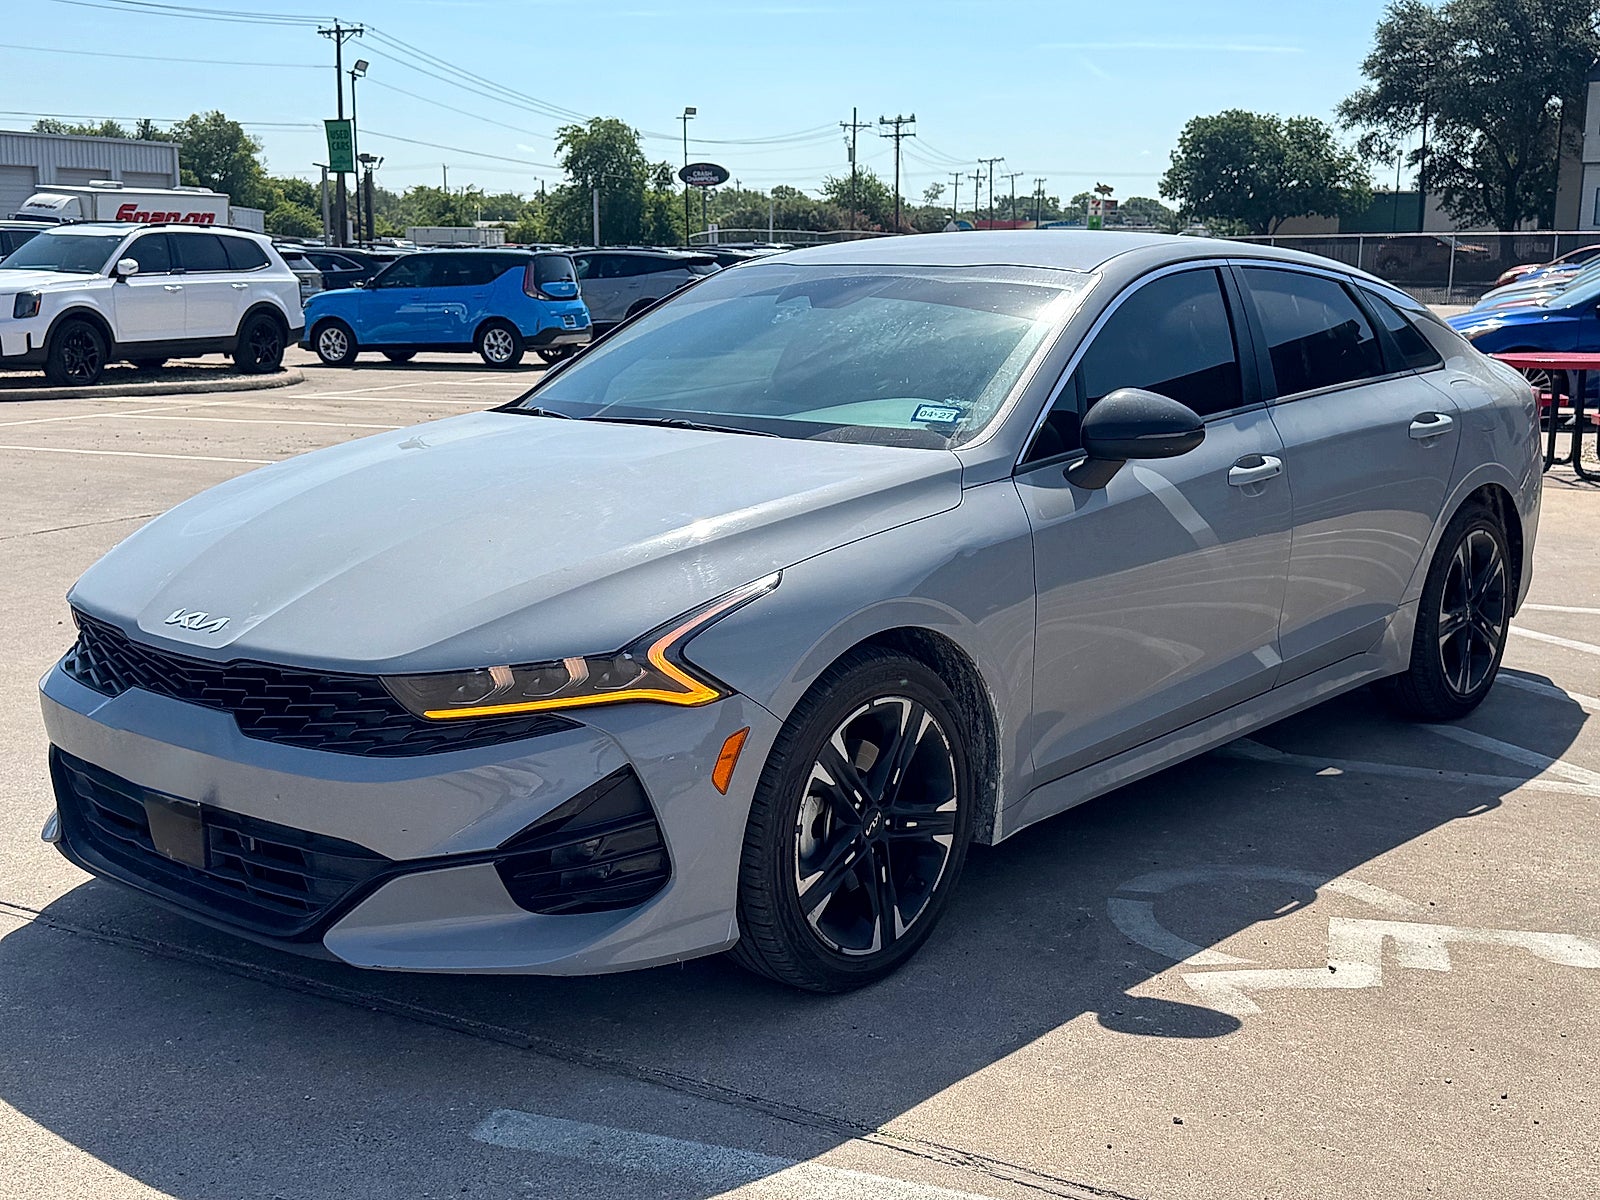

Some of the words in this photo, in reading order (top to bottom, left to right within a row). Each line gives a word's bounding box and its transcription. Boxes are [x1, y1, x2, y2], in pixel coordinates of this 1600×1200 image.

[329, 129, 349, 140] USED
[331, 141, 350, 151] CARS
[164, 607, 231, 634] KIA
